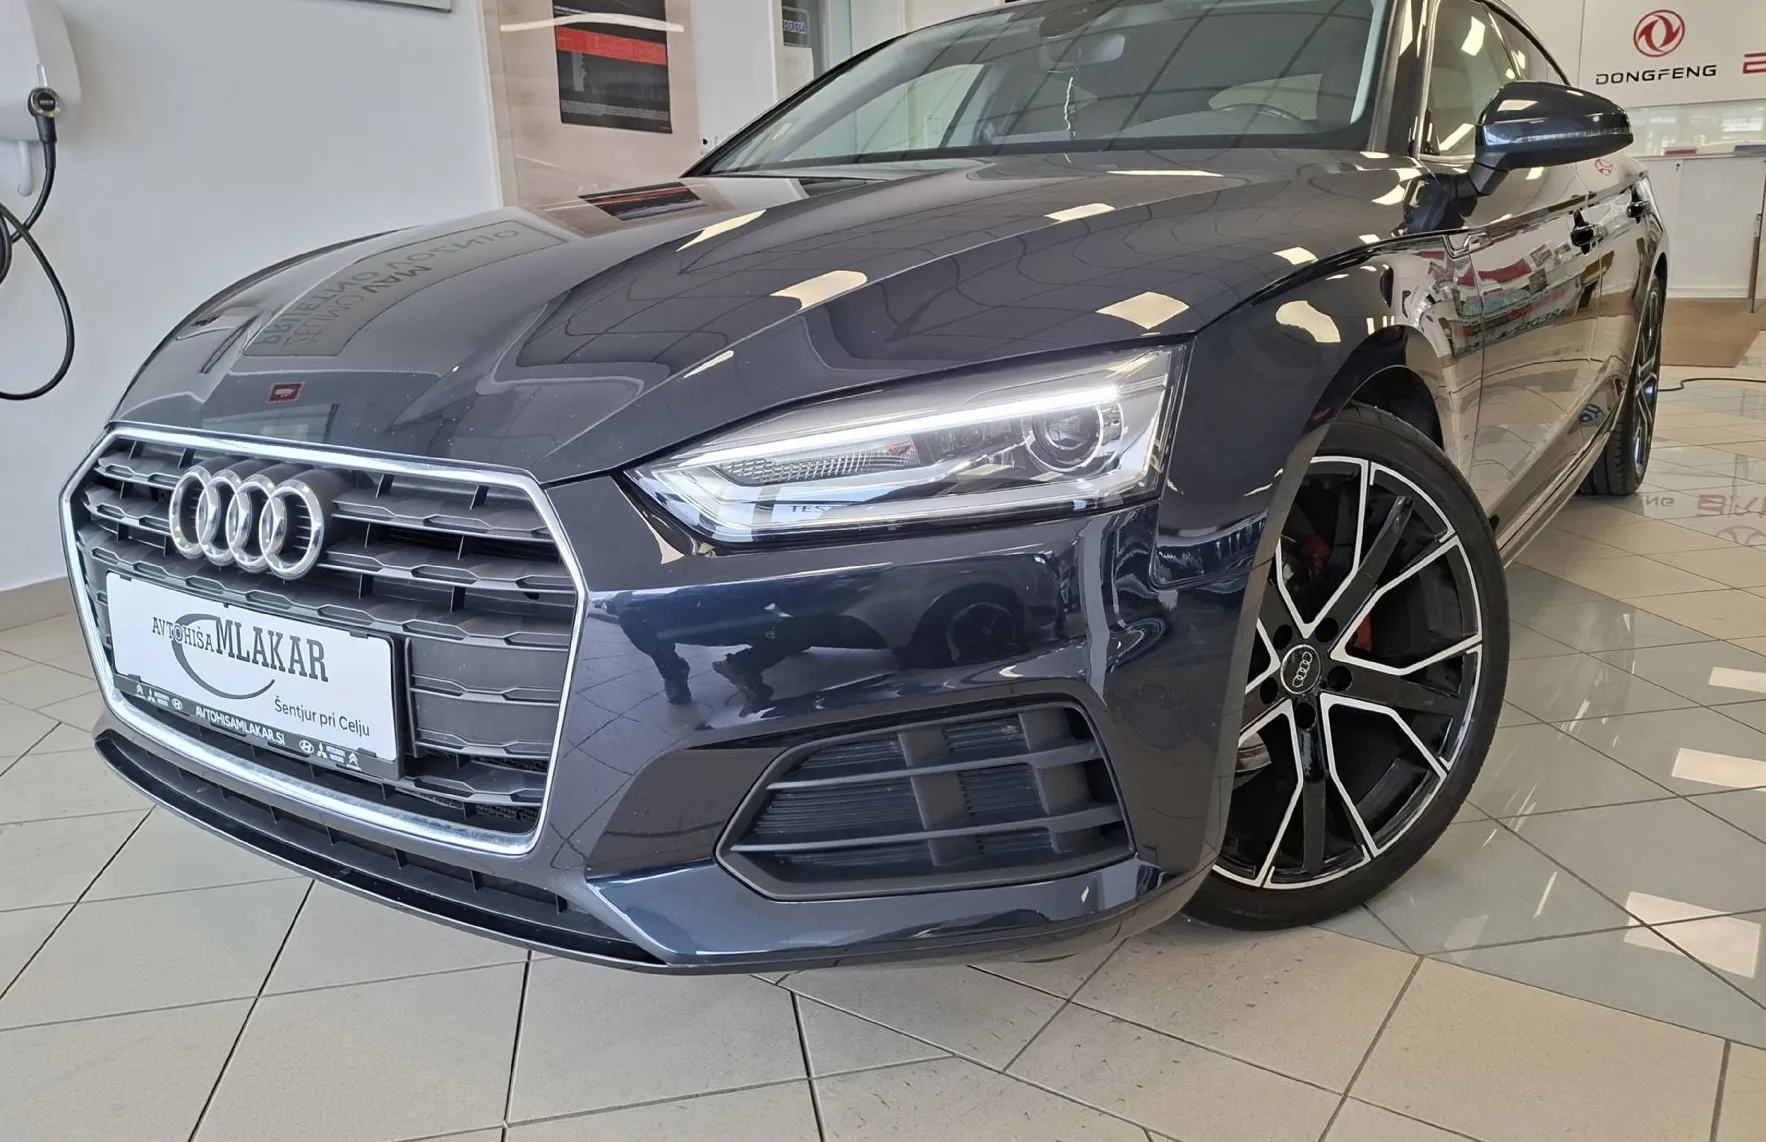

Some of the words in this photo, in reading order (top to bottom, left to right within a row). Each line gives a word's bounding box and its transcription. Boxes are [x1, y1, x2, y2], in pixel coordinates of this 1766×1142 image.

[1596, 64, 1717, 85] DONGFENG
[215, 617, 329, 682] MLAKAR
[275, 695, 317, 722] Šentjur
[319, 713, 336, 728] pri
[338, 715, 370, 737] Celju
